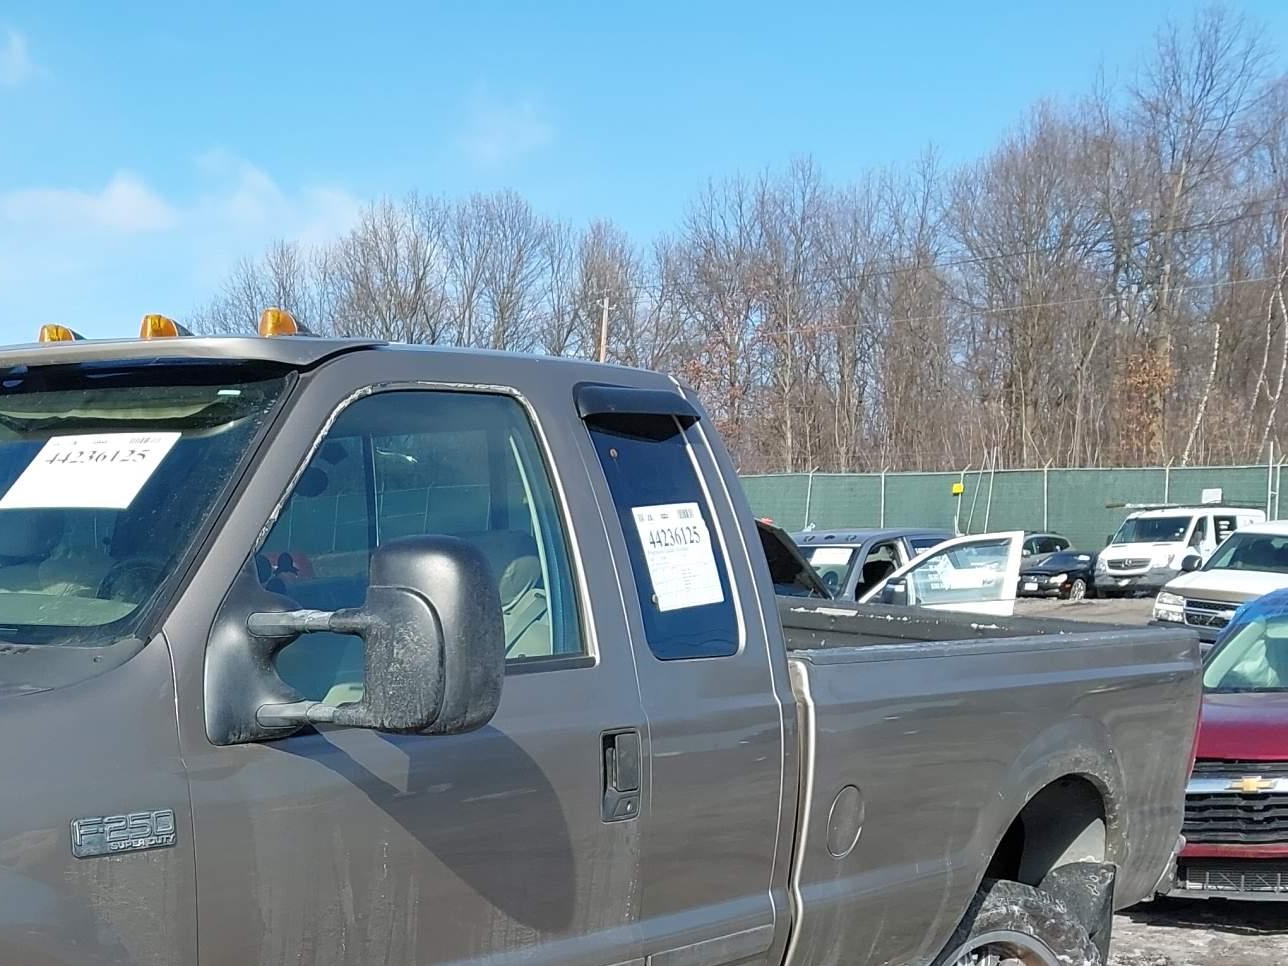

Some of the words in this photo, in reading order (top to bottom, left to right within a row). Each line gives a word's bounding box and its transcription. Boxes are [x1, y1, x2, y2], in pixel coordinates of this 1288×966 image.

[45, 449, 151, 465] 44236125
[648, 525, 701, 549] 44236125
[110, 838, 146, 851] SUPER
[147, 832, 177, 846] DUTY
